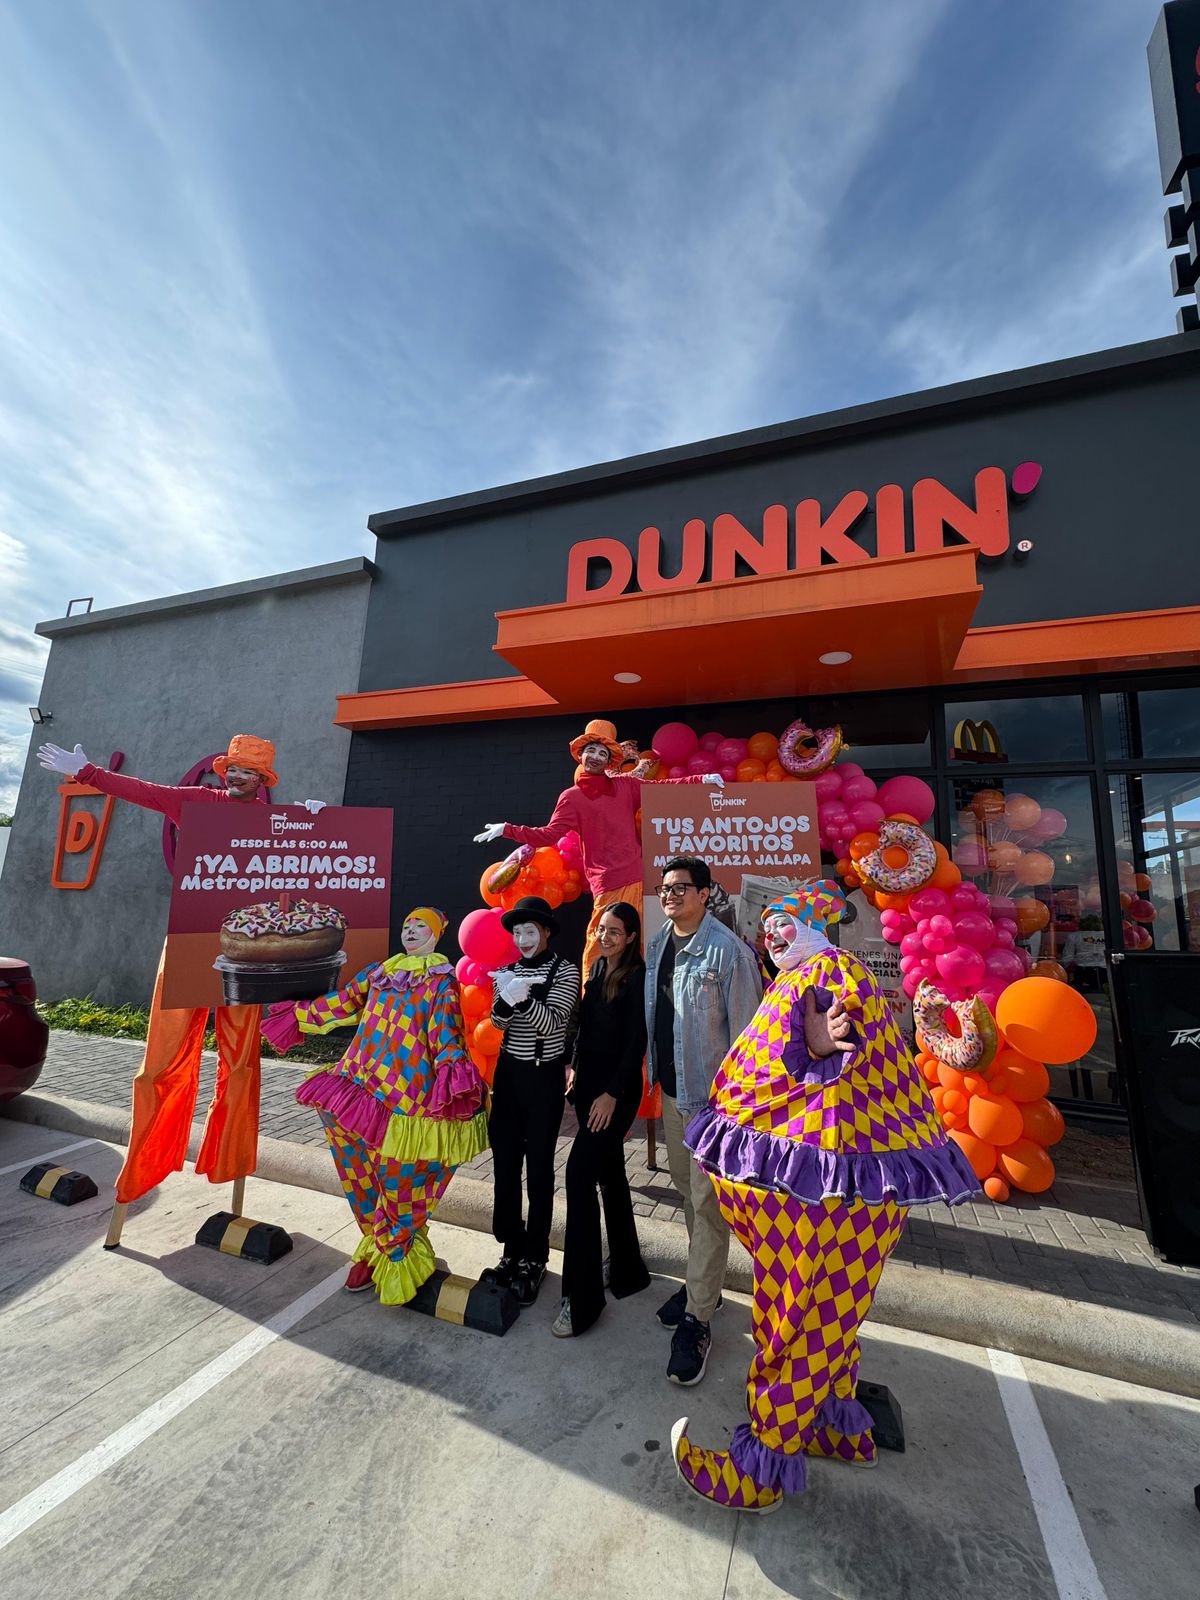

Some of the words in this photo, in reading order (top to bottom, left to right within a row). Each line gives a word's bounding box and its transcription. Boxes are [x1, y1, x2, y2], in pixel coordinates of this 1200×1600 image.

[566, 461, 1043, 603] DUNKIN'
[713, 798, 747, 806] DUNKIN'
[65, 811, 98, 853] D
[274, 821, 315, 831] DUNKIN'
[651, 817, 695, 835] TUS
[700, 815, 811, 834] ANTOJOS
[230, 838, 271, 849] DESDE
[274, 839, 297, 849] LAS
[299, 840, 327, 850] 6:00
[329, 840, 349, 850] AM
[669, 834, 794, 853] FAVORITOS
[194, 854, 239, 876] ¡YA
[245, 854, 376, 875] ABRIMOS!
[653, 854, 752, 867] MEPLAZA
[755, 853, 812, 866] JALAPA
[180, 874, 310, 893] Metroplaza
[315, 874, 386, 892] Jalapa
